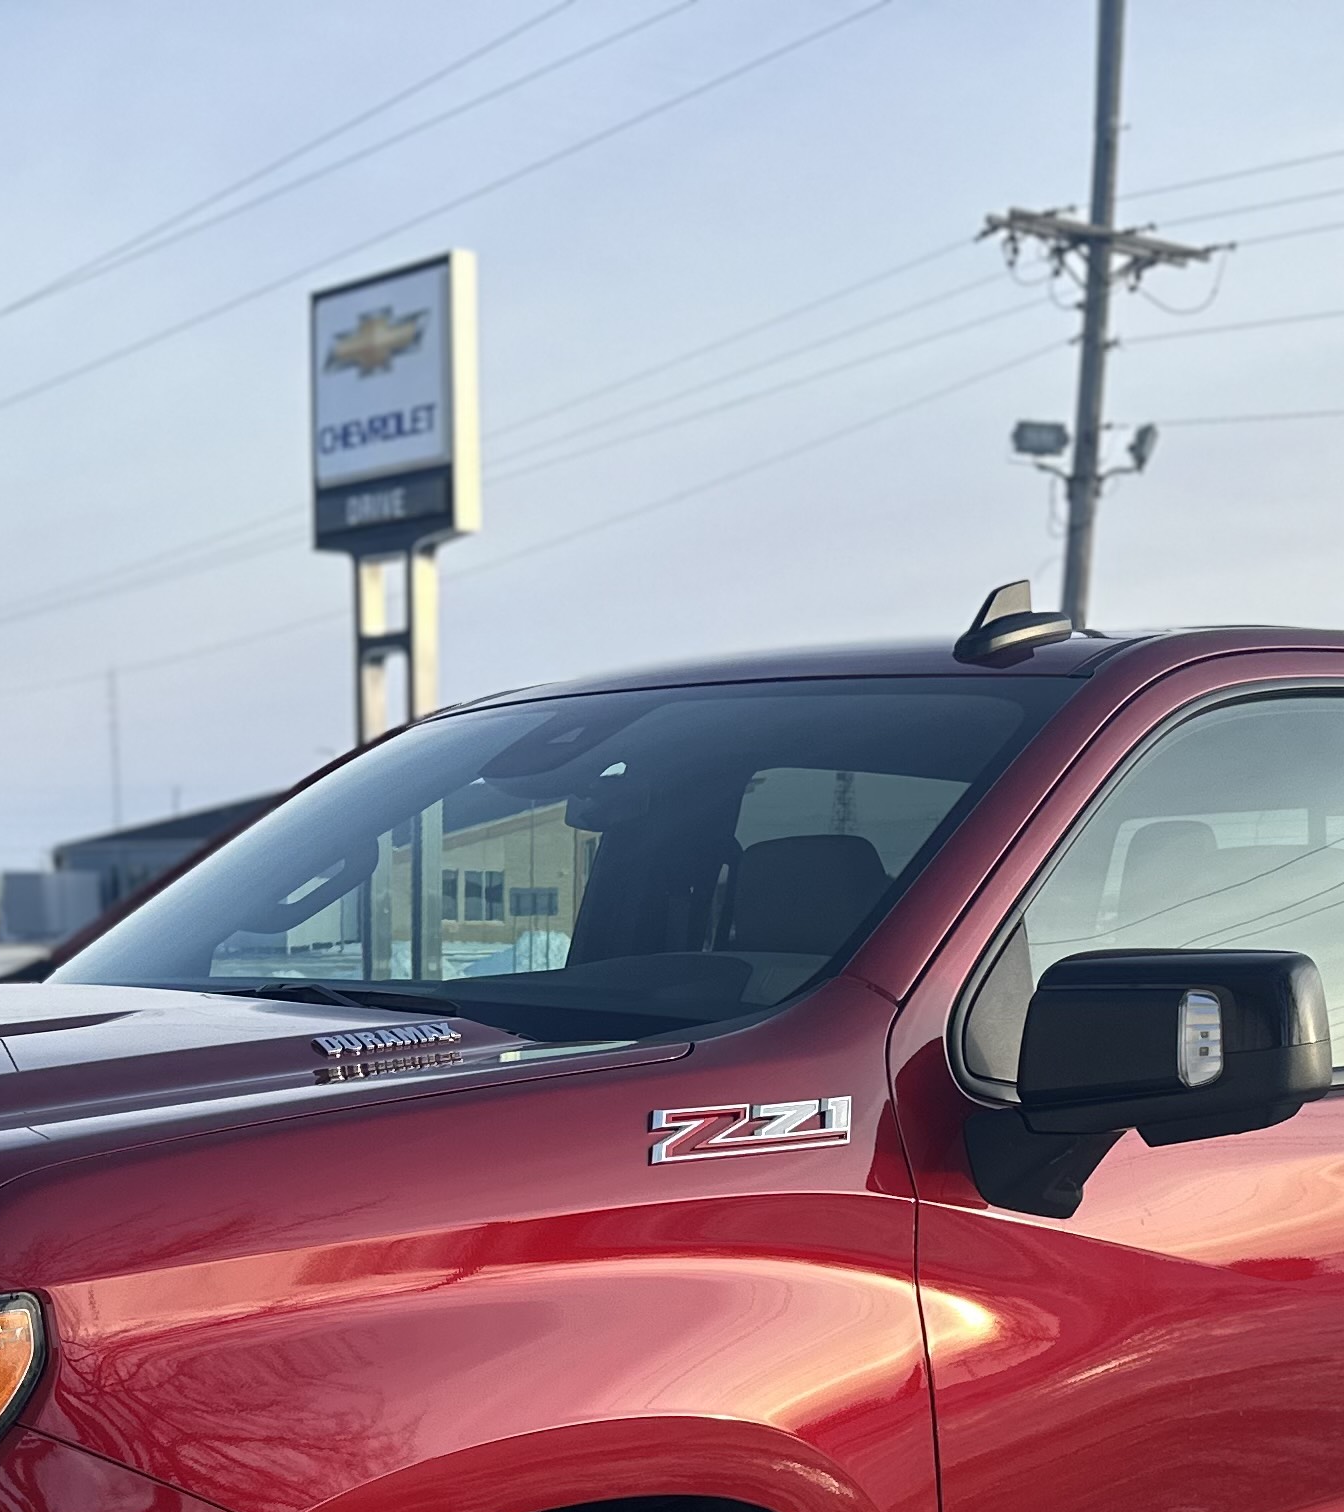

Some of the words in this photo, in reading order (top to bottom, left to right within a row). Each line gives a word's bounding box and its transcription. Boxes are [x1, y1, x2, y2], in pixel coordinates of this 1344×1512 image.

[319, 403, 436, 455] CHEVROLET
[311, 1022, 462, 1057] DURAMAX
[648, 1096, 852, 1166] Z71
